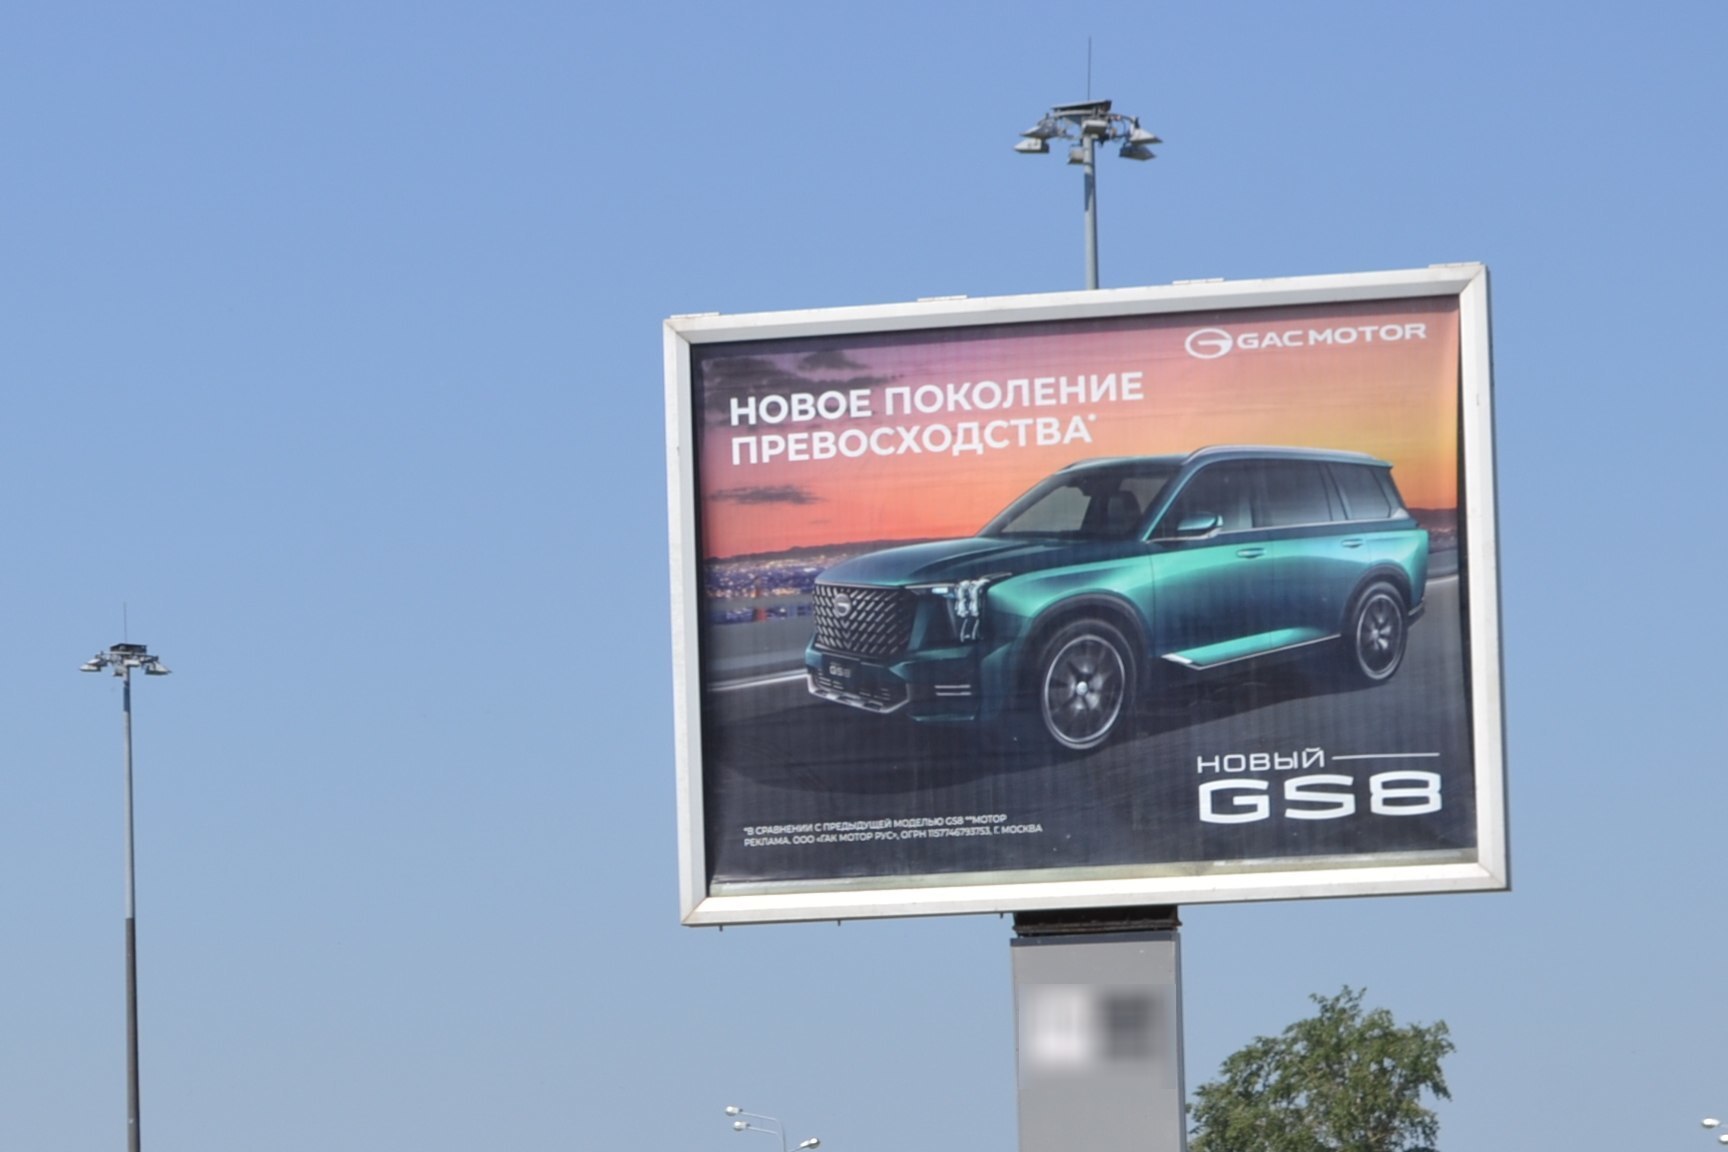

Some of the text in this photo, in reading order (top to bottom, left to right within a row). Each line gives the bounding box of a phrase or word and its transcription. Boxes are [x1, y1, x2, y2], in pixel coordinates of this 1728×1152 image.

[1236, 323, 1426, 349] GAC MOTOR
[729, 371, 1144, 426] НОВОЕ ПОКОЛЕНИЕ
[1197, 747, 1325, 773] НОВЫЙ
[1198, 770, 1442, 824] GS8
[755, 823, 813, 835] СРАВНЕНИИ
[814, 822, 823, 832] С
[823, 818, 892, 832] ПРЕДЫДУЩЕЙ
[893, 817, 944, 828] МОДЕЛЬЮ
[945, 816, 964, 826] GS8
[792, 835, 815, 845] ООО
[838, 832, 874, 842] МОТОР
[900, 829, 927, 839] ОГРН
[1001, 823, 1043, 834] МОСКВА
